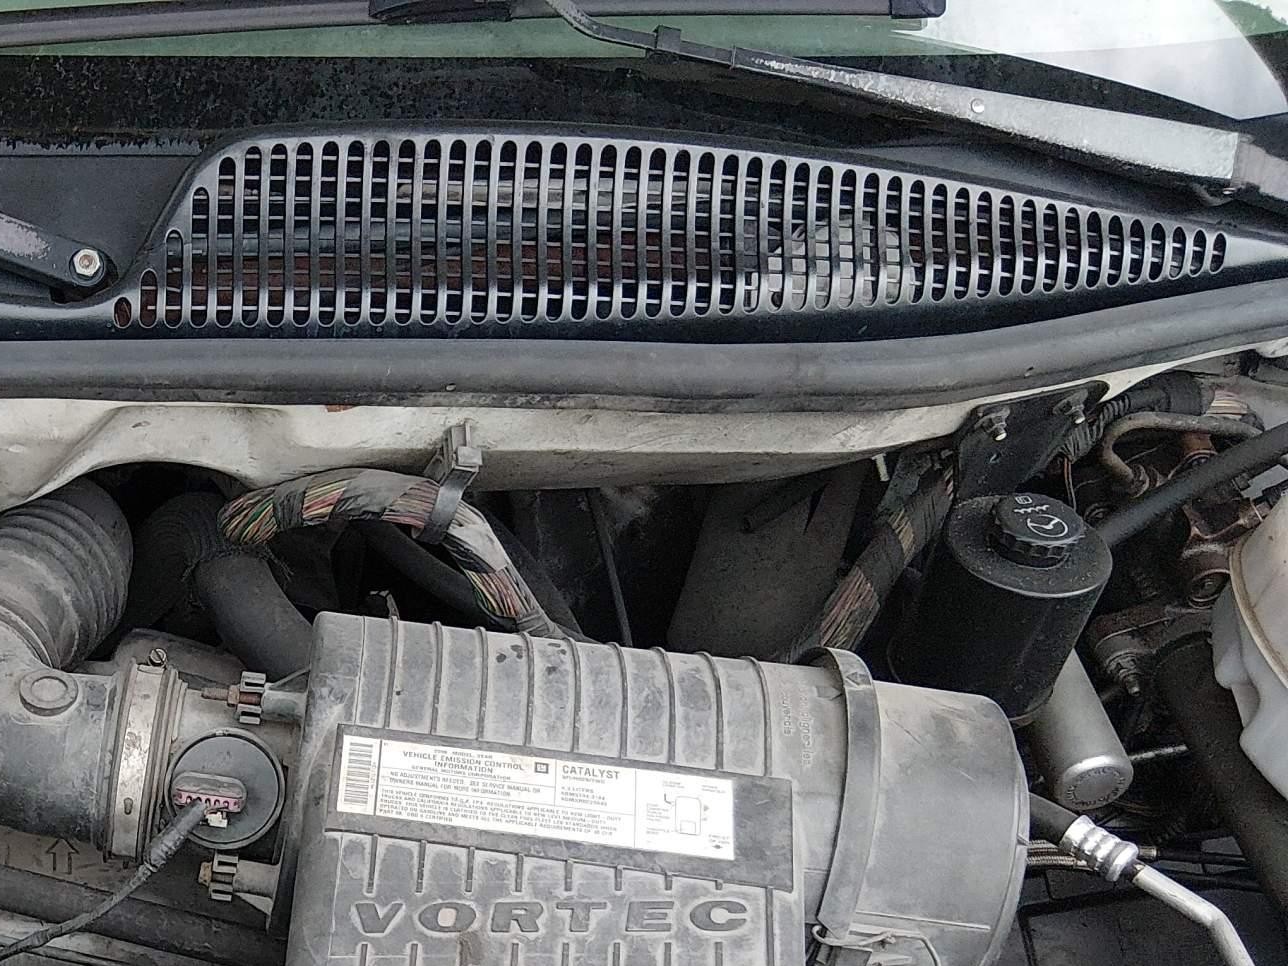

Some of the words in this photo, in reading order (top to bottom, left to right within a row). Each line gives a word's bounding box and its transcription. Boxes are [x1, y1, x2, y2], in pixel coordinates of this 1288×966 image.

[402, 751, 436, 760] VEHICLE
[440, 755, 481, 765] EMISSION
[484, 760, 524, 770] CONTROL
[434, 761, 493, 773] INFORMATION
[562, 765, 620, 780] CATALYST
[354, 901, 748, 934] VORTEC
